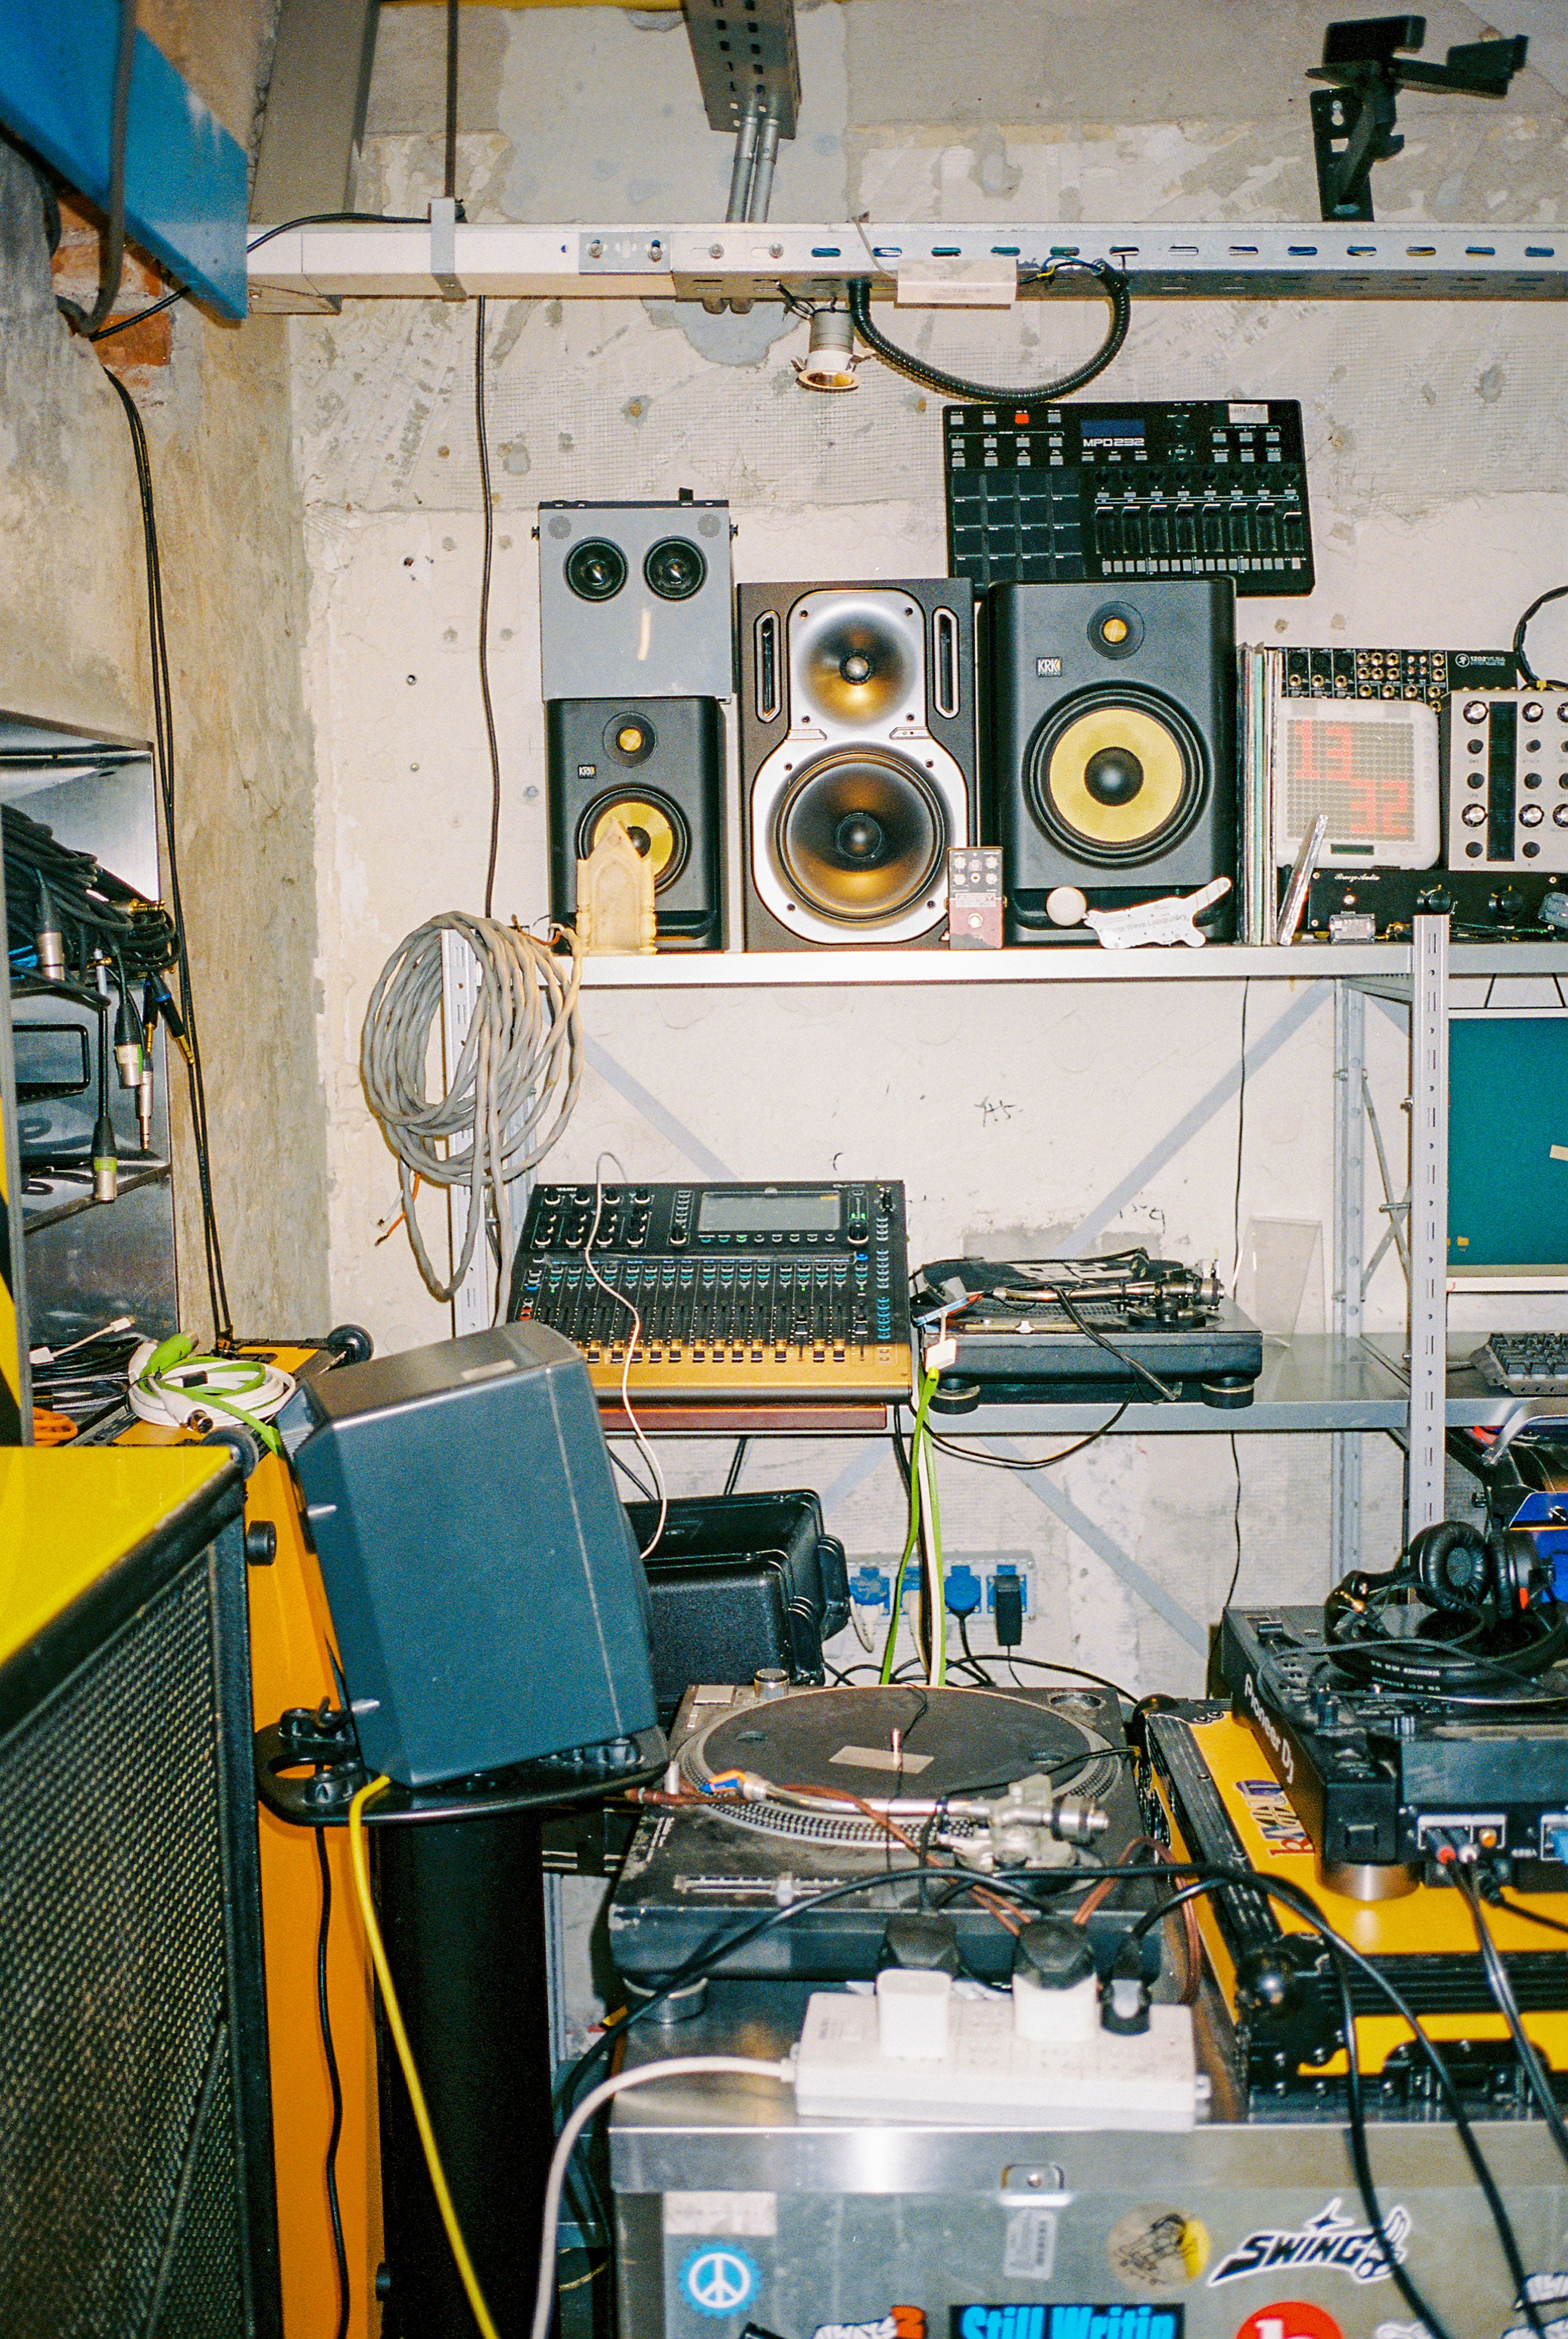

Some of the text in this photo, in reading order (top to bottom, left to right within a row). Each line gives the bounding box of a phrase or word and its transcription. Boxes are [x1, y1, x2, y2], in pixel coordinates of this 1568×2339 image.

[1083, 437, 1145, 447] MPD232
[1038, 659, 1058, 672] KRK
[1295, 720, 1352, 779] 13
[579, 766, 593, 775] KRK
